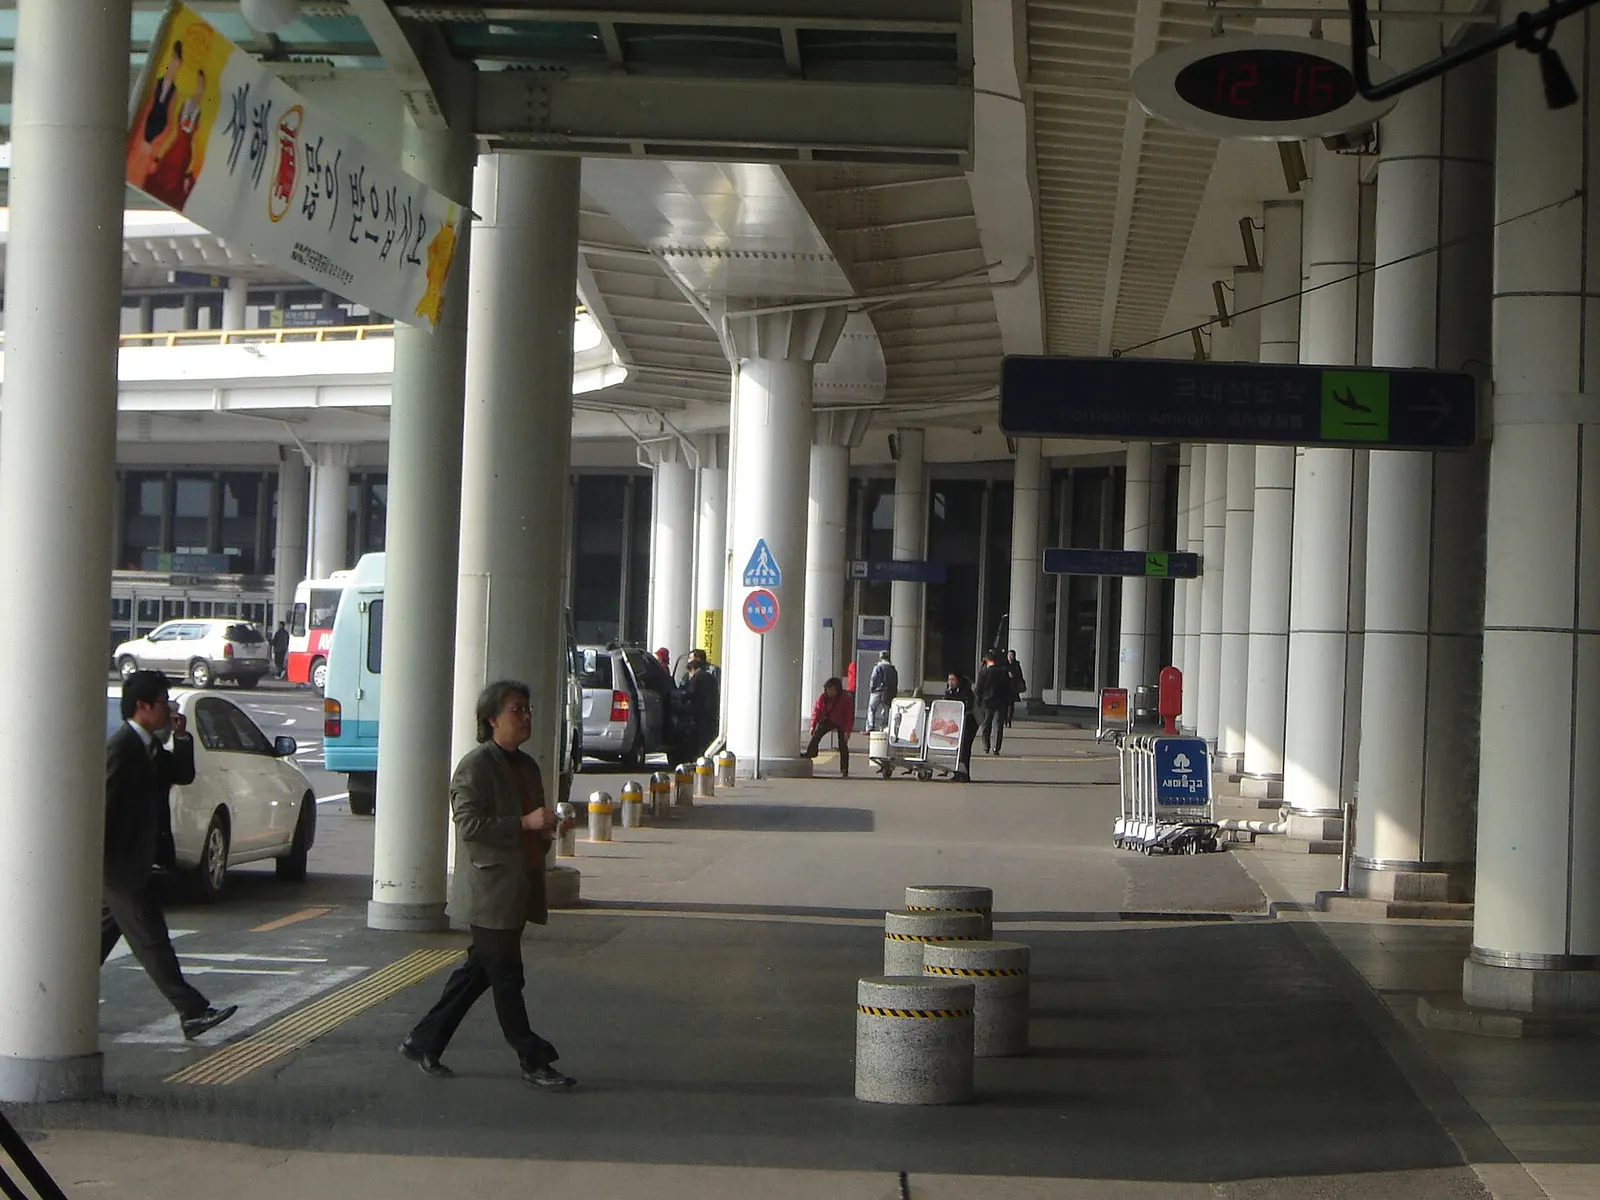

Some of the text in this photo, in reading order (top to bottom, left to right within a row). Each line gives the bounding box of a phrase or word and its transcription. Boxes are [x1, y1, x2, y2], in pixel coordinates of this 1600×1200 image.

[1215, 62, 1334, 108] 12 16
[221, 81, 272, 191] 새해
[302, 135, 342, 233] 많이
[348, 164, 427, 270] 받으십시오
[1162, 774, 1203, 793] 새마을금고
